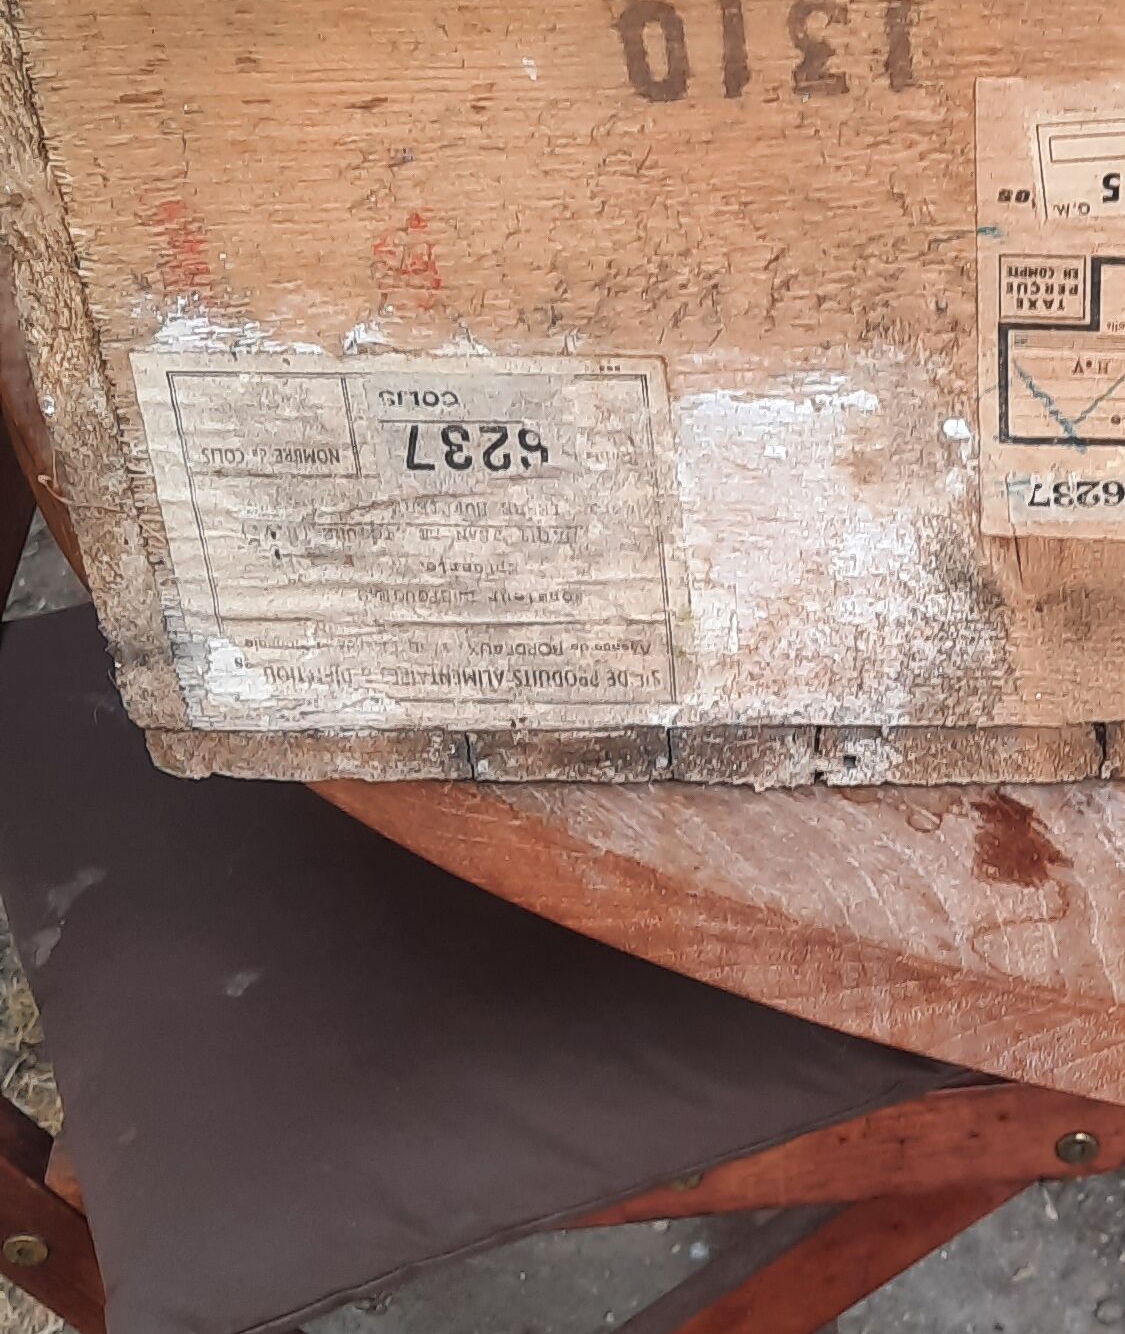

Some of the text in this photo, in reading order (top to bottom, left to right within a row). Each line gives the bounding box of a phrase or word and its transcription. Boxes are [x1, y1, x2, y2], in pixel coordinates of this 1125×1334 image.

[1006, 266, 1079, 280] EN COMPTE
[1006, 280, 1079, 296] PERÇUE
[1015, 297, 1066, 312] TAXE
[379, 390, 459, 408] COLIS
[200, 447, 245, 465] COLIS
[274, 447, 340, 465] NOMBRE
[405, 424, 549, 472] 6237
[1027, 480, 1125, 508] 6237
[512, 669, 599, 688] PRODUITS
[607, 670, 629, 687] DE
